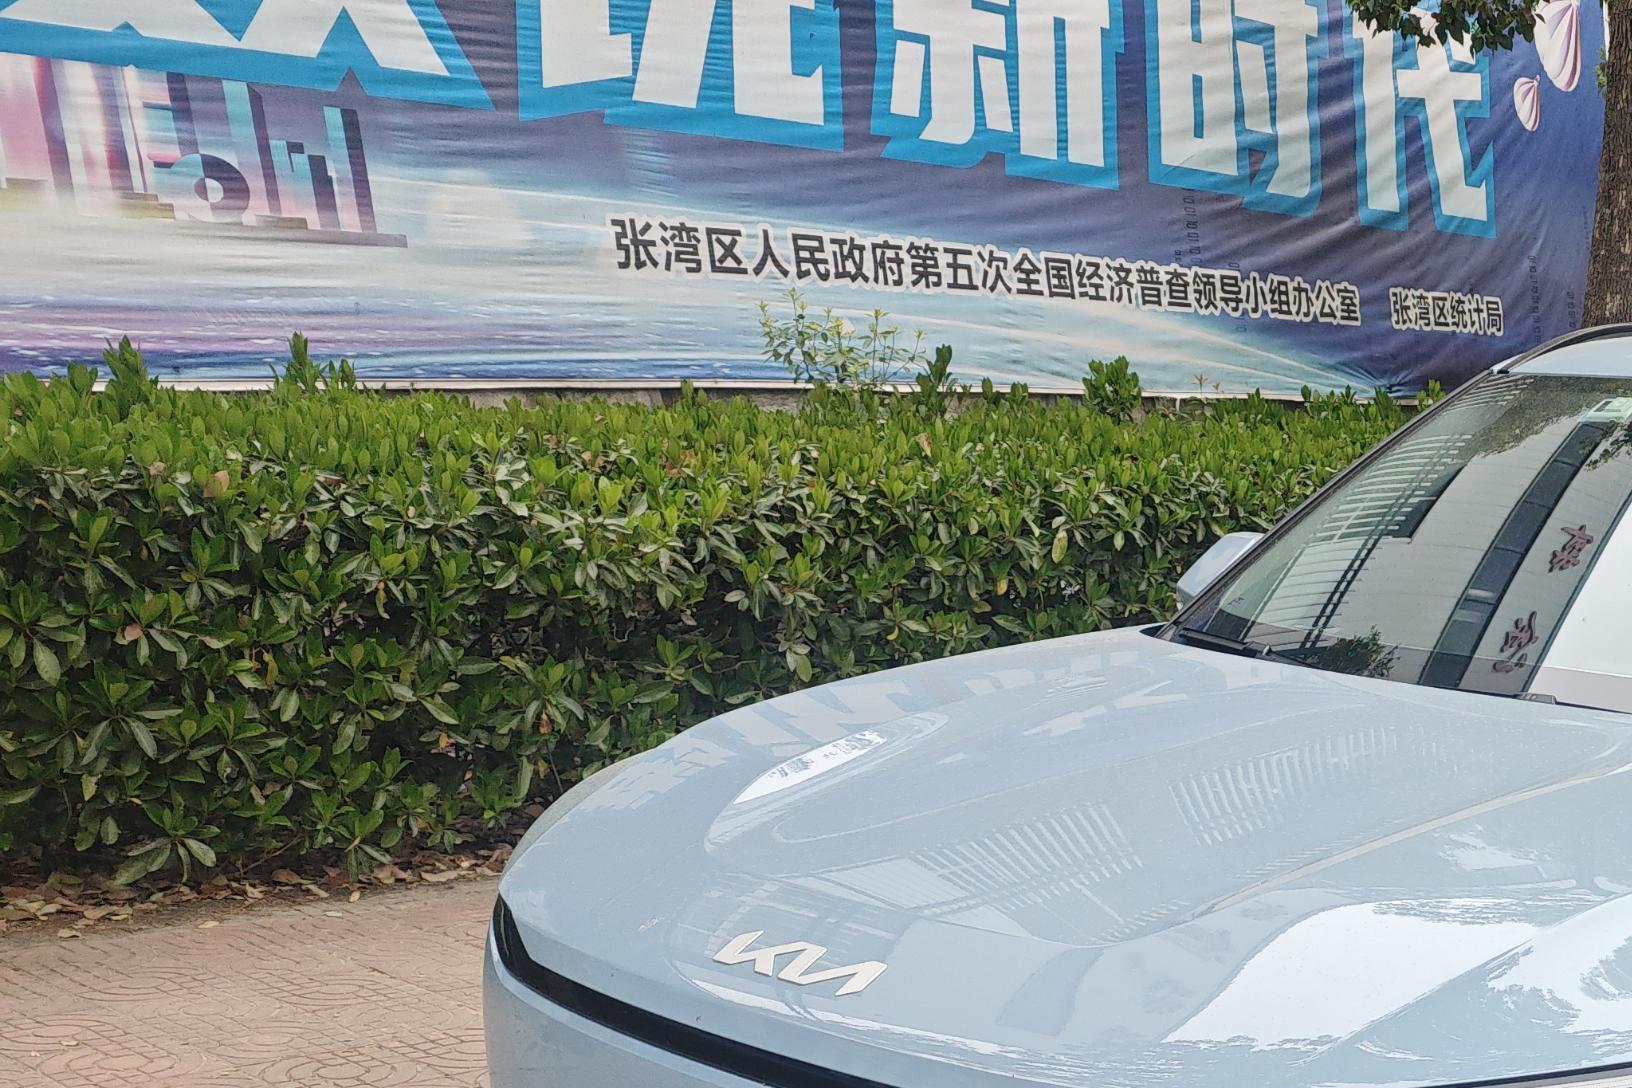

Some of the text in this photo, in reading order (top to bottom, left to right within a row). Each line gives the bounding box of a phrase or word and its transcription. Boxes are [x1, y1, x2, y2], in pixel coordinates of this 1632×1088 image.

[610, 216, 1360, 323] 张湾区人民政府第五次全国经济普查领导小组办公室
[1391, 289, 1502, 333] 张湾区统计局
